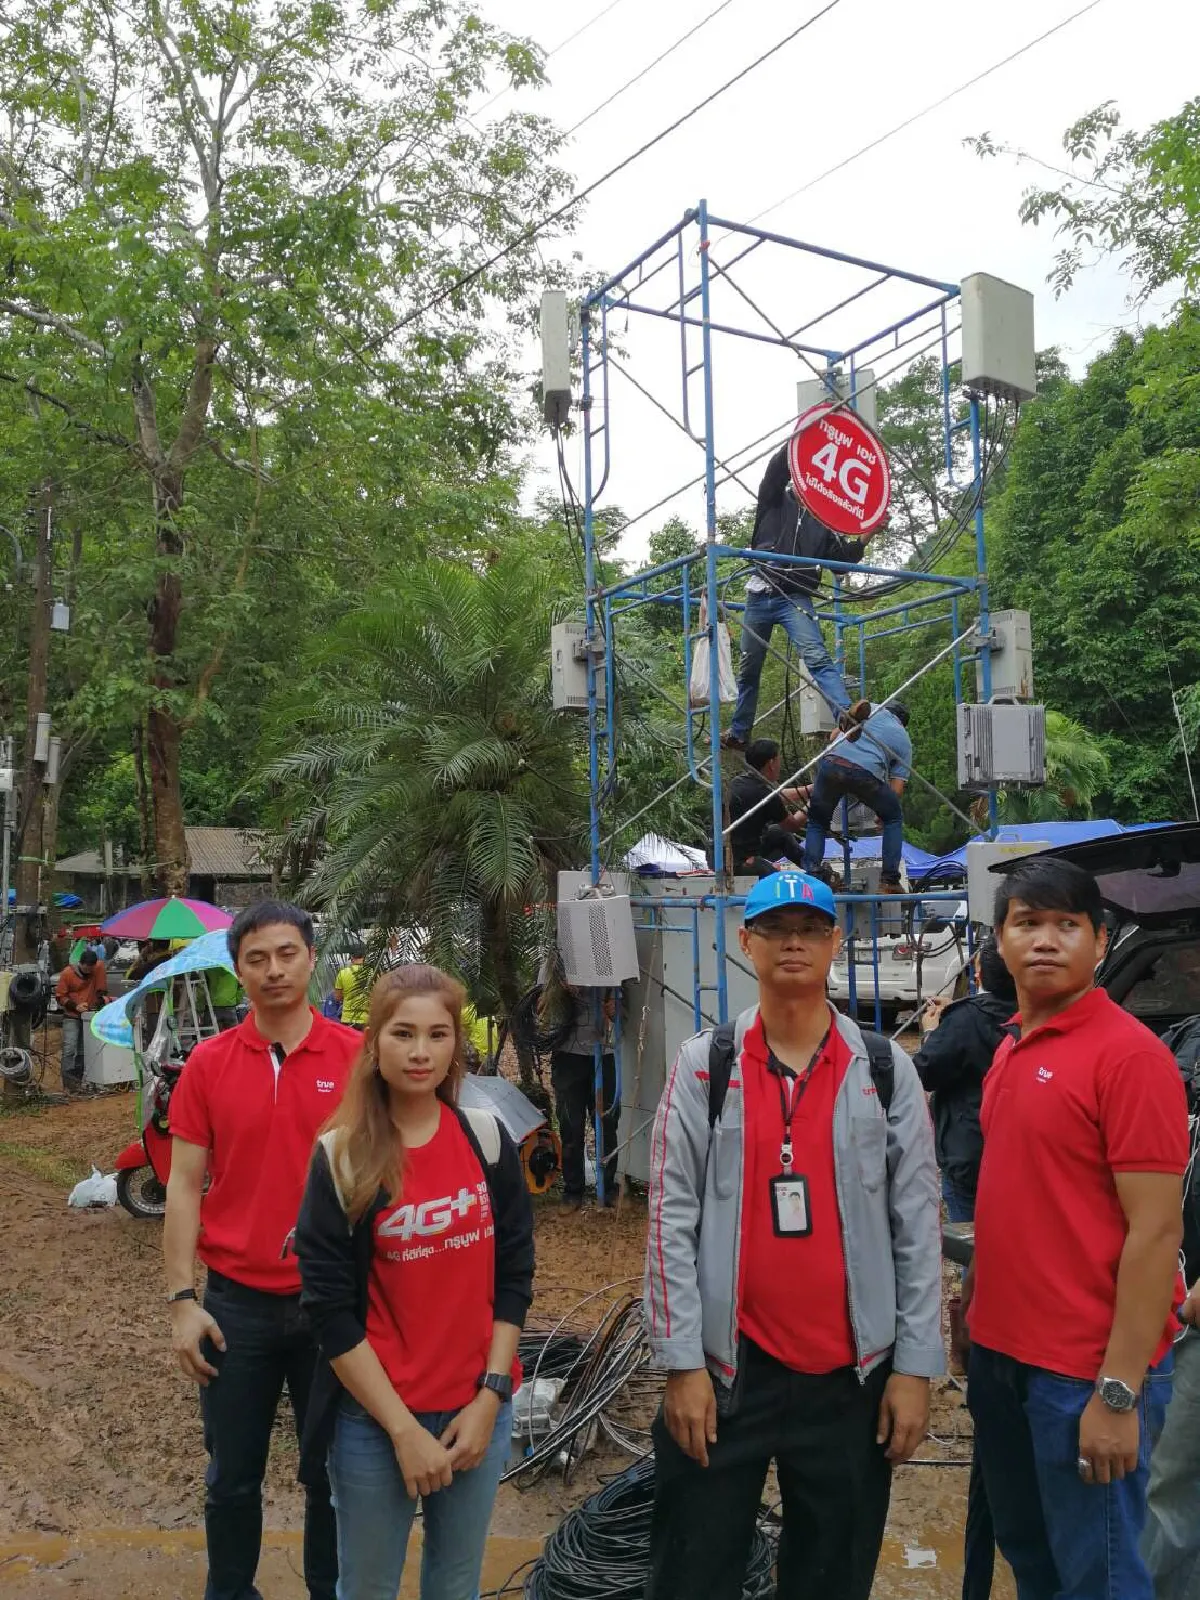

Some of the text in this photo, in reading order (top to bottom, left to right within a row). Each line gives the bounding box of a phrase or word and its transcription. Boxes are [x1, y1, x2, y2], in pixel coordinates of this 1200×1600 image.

[811, 442, 871, 504] 4G
[776, 879, 814, 901] ITA
[316, 1080, 334, 1089] true
[378, 1187, 477, 1241] 4G+
